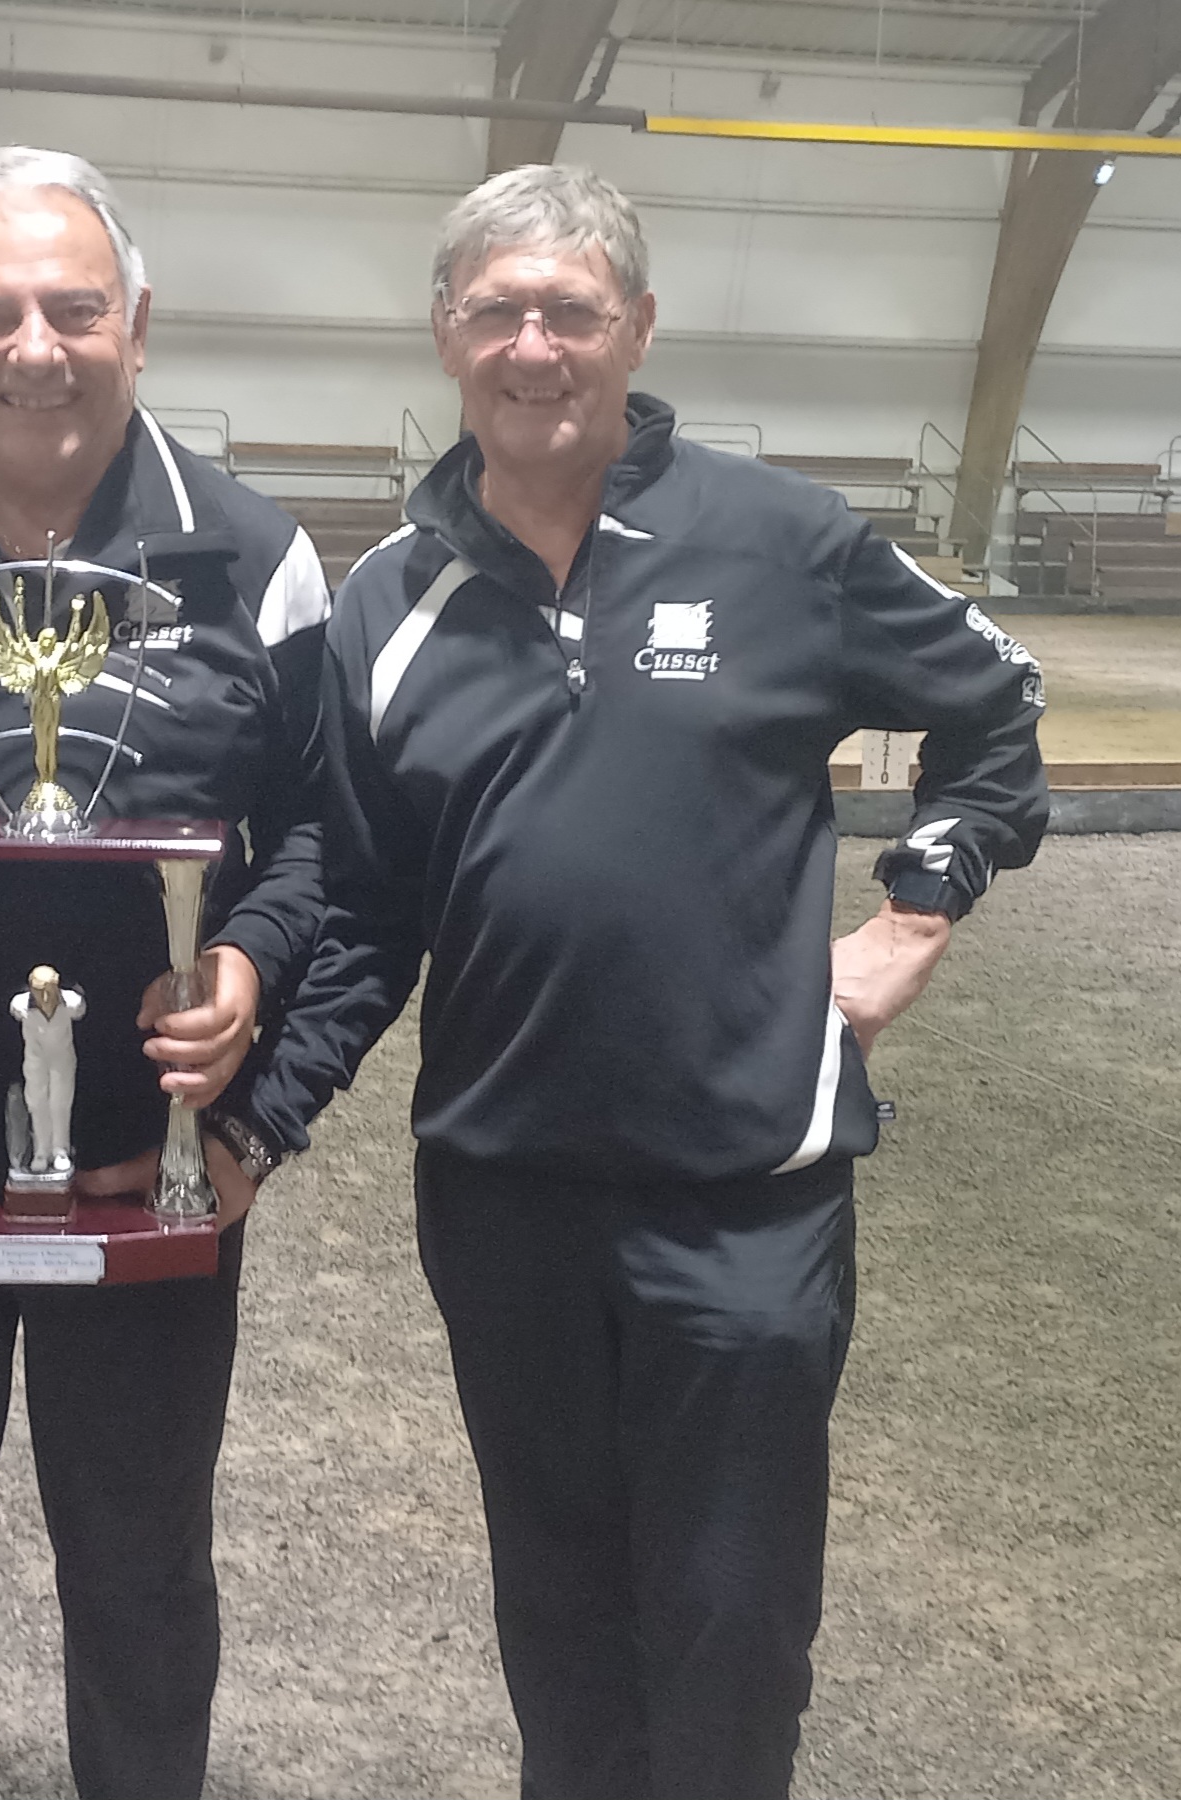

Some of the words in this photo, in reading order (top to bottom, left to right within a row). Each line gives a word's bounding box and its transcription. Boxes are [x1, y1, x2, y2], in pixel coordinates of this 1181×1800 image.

[634, 647, 720, 672] Cusset
[882, 743, 890, 756] 2
[880, 771, 889, 784] 0
